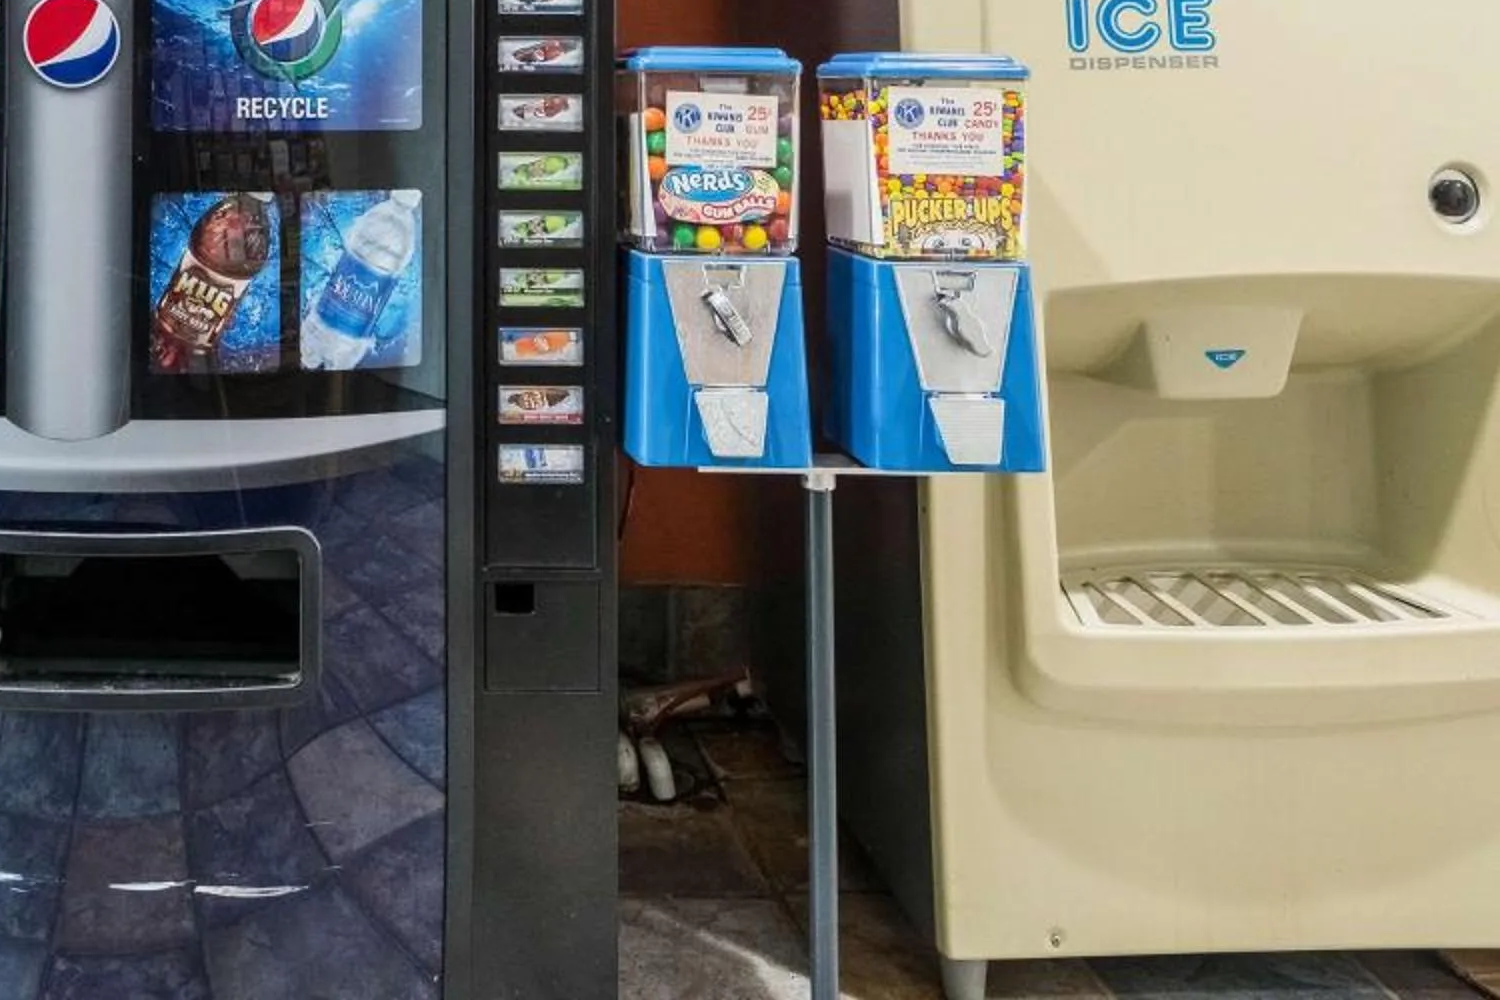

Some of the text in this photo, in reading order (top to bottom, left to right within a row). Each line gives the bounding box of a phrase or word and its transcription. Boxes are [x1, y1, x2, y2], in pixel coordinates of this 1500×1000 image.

[1069, 55, 1220, 70] DISPENSER
[236, 97, 329, 119] RECYCLE
[912, 131, 984, 142] THANKS YOU
[891, 196, 1013, 237] PUCKER UPS
[174, 271, 233, 318] MUG
